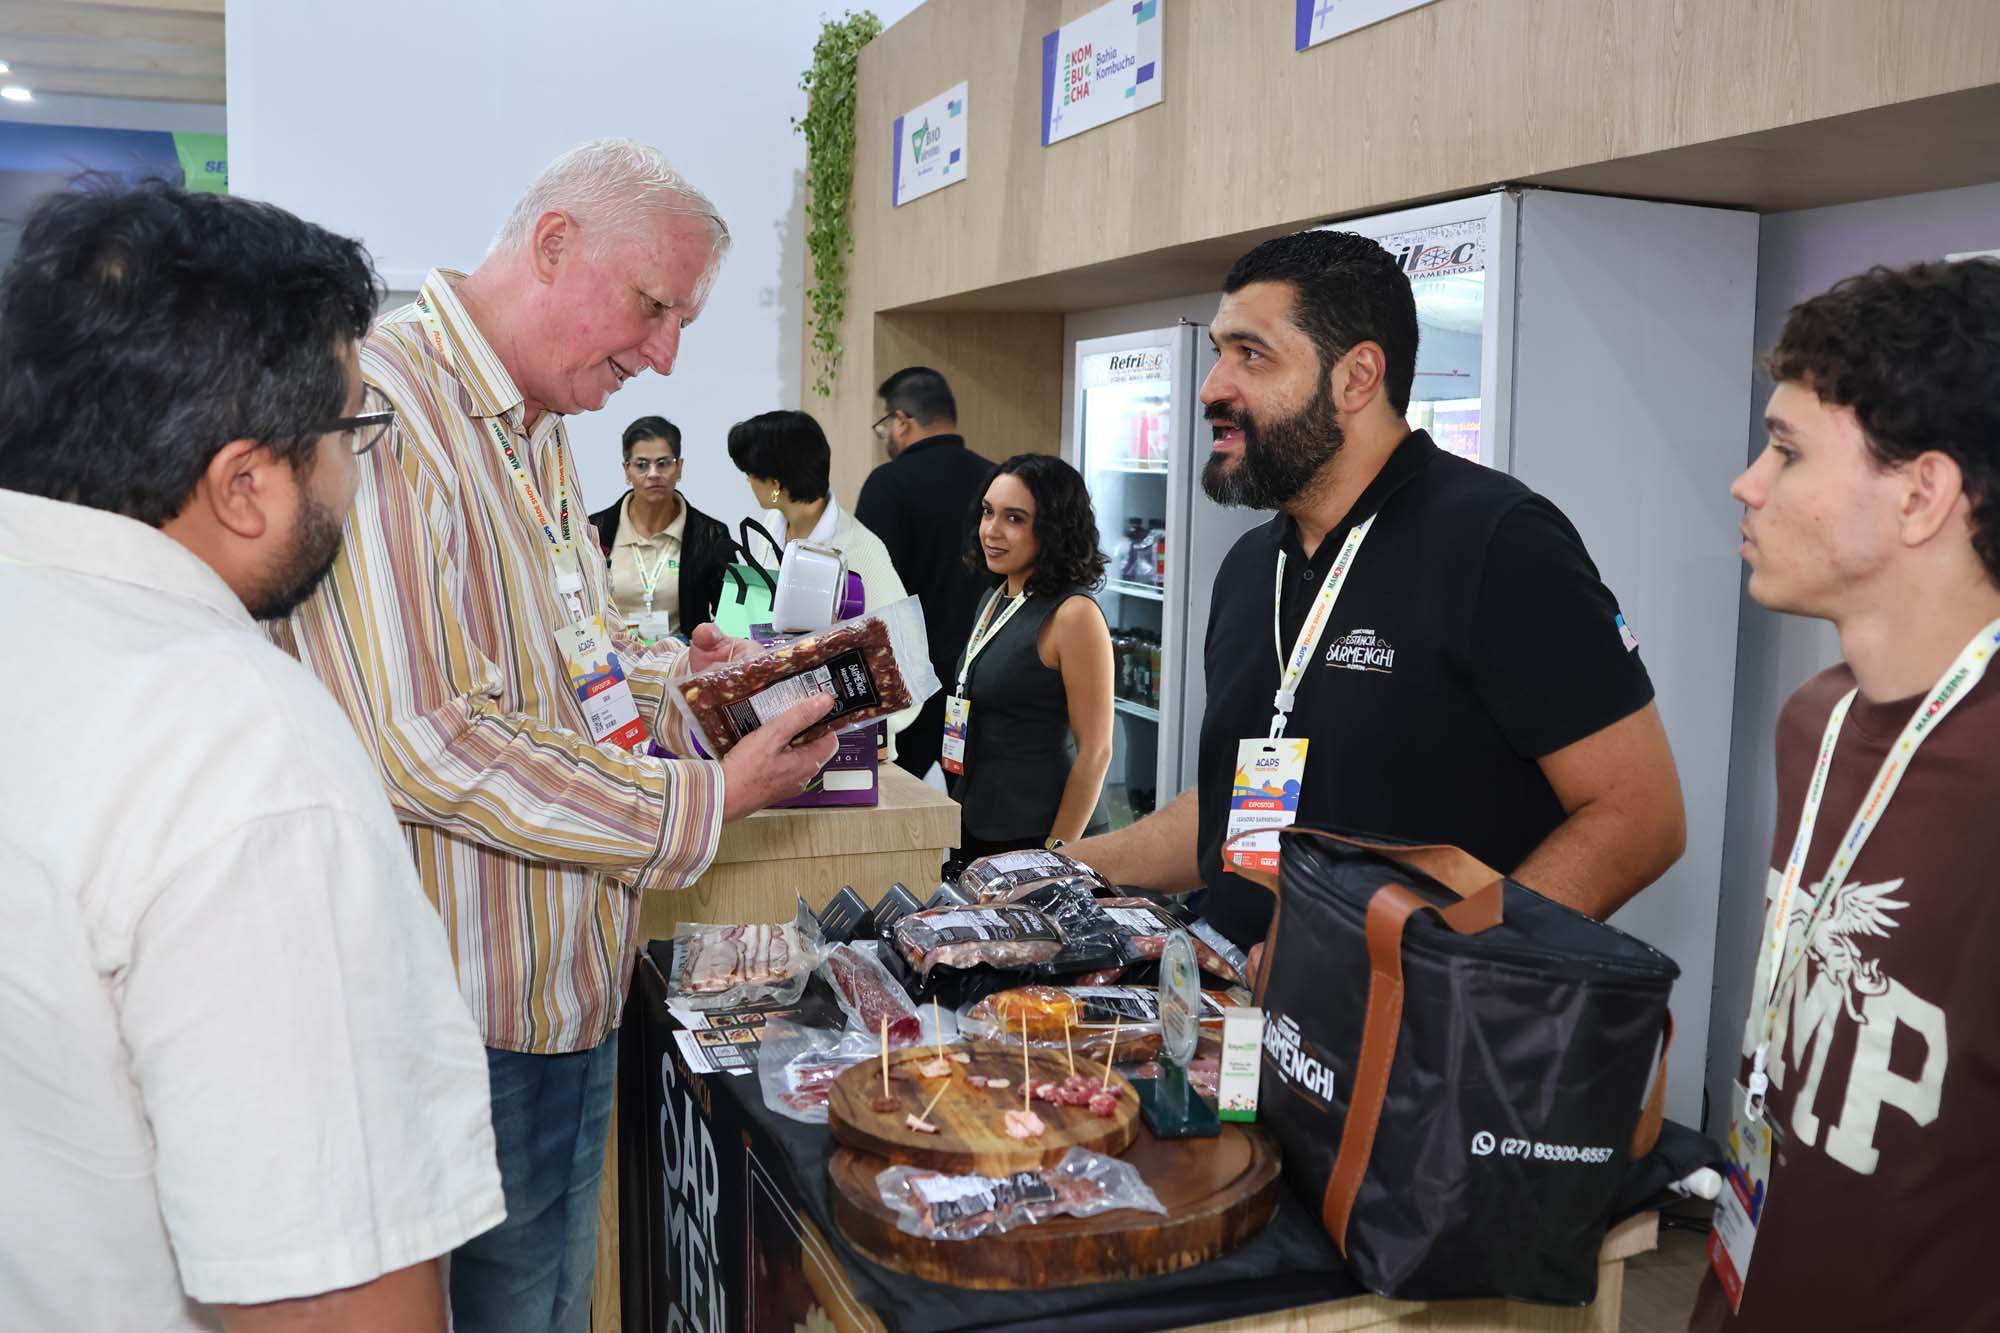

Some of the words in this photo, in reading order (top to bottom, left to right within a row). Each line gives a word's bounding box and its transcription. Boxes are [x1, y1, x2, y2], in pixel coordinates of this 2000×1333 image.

[1071, 43, 1093, 65] KOM
[1096, 47, 1118, 67] Bahia
[1096, 55, 1136, 81] Kombucha
[1070, 81, 1090, 102] CHA
[925, 126, 941, 147] BIO
[1409, 268, 1473, 280] IPAMENTOS
[523, 482, 538, 505] SHOW
[1295, 645, 1308, 669] ACAPS
[1325, 643, 1395, 668] SARMENGHI
[1255, 757, 1280, 767] ACAPS
[1500, 1136, 1532, 1159] (27)
[1533, 1141, 1614, 1164] 93300-6557
